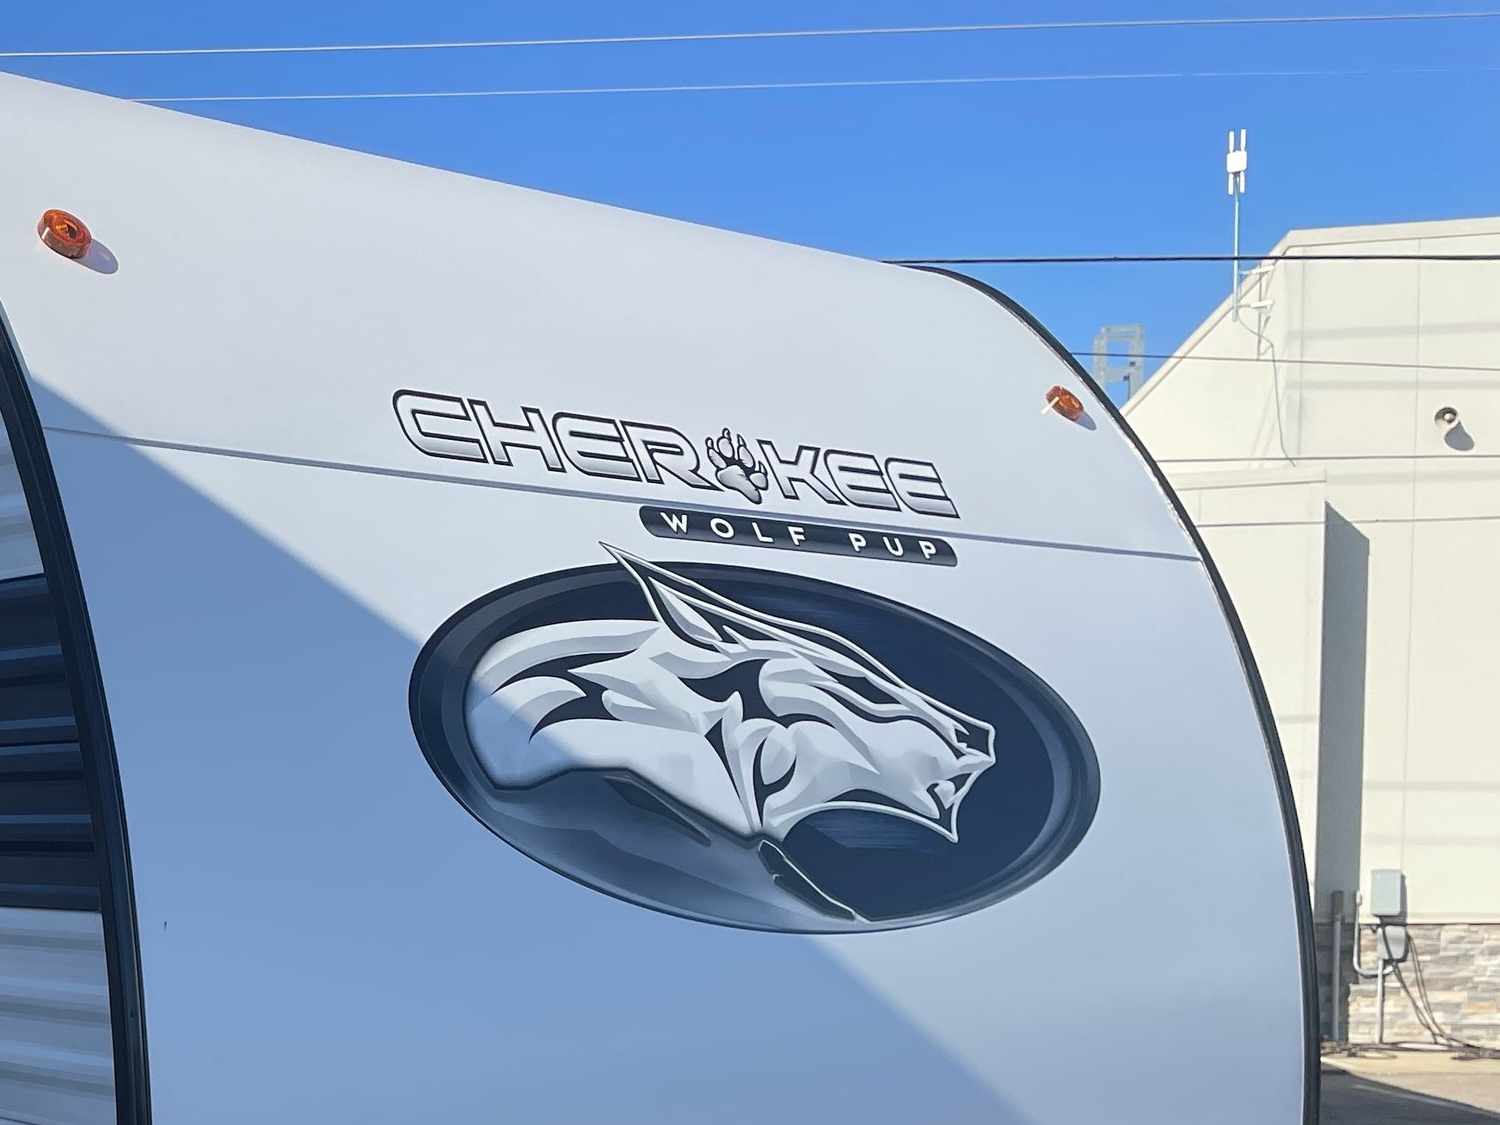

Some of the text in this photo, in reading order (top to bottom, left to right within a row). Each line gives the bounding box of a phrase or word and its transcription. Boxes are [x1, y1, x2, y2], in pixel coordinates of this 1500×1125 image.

[392, 388, 960, 520] CHEROKEE
[659, 510, 937, 559] WOLF PUP
